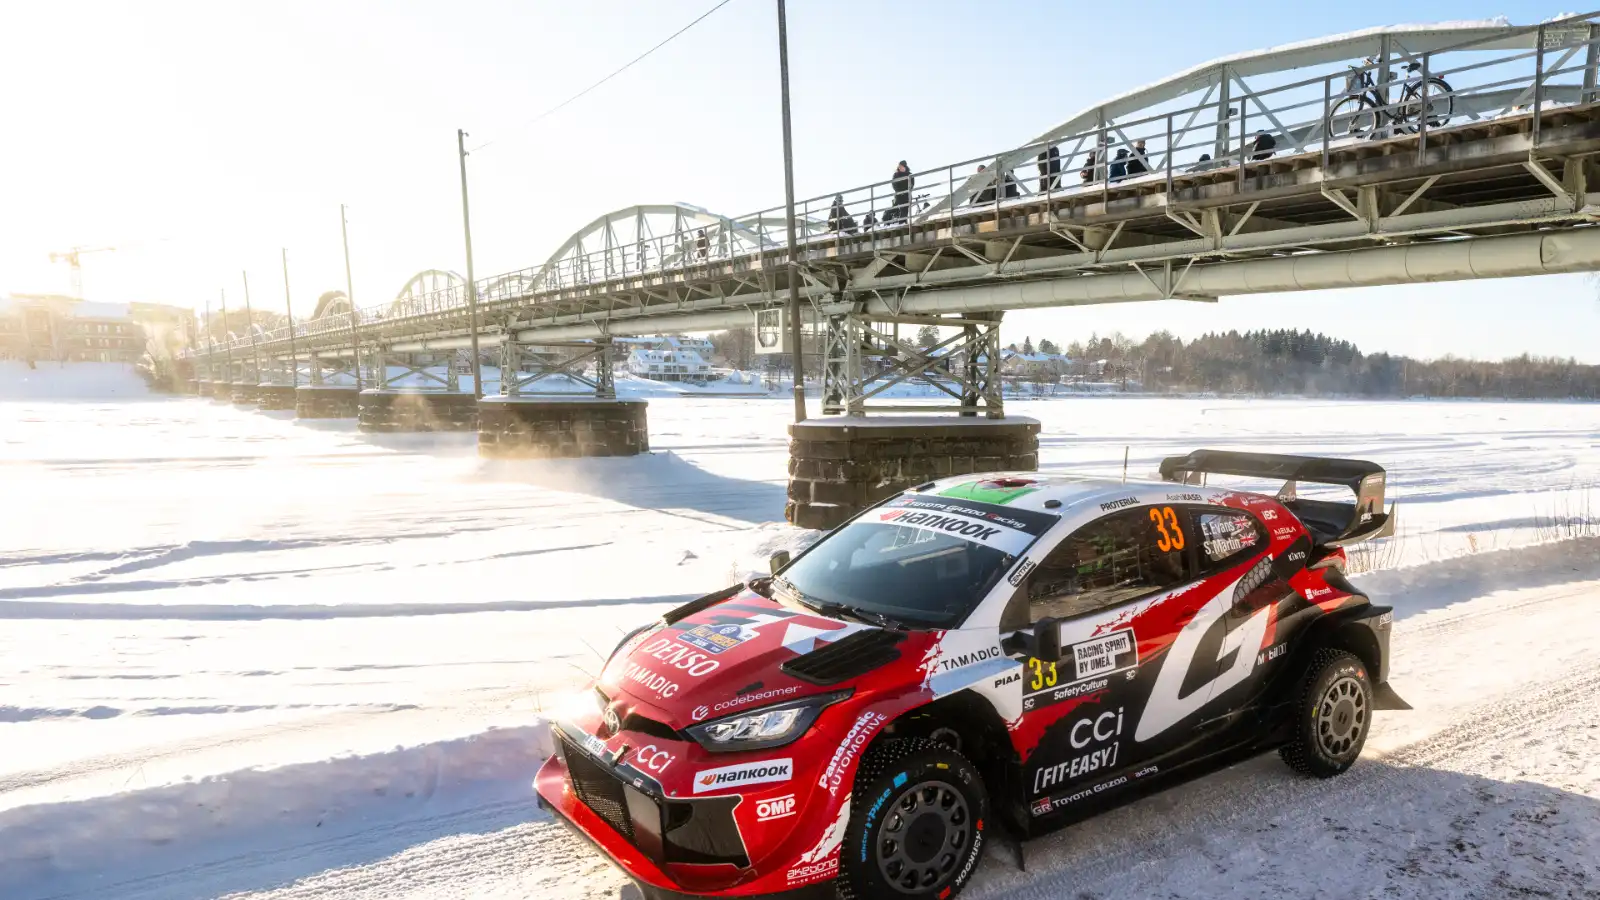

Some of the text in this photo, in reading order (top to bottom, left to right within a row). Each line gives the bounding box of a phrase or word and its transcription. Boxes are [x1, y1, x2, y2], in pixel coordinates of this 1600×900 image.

[909, 501, 945, 510] TOYOTA
[986, 513, 1026, 529] Racing
[1100, 496, 1140, 511] PROTERIAL
[1149, 506, 1185, 552] 33
[1009, 559, 1034, 587] CENTRAL
[641, 638, 720, 677] DENSO
[940, 646, 999, 671] TAMADIC
[1077, 637, 1127, 660] RACING SPIRIT
[624, 662, 679, 698] TAMADIC
[994, 673, 1021, 688] PIAA
[1028, 656, 1058, 690] 33
[1079, 660, 1089, 674] BY
[714, 686, 799, 711] codebeamer
[1054, 679, 1108, 700] SafetyCulture
[818, 711, 875, 790] Panasonic
[829, 713, 888, 797] AUTOMOTIVE
[1052, 789, 1093, 808] TOYOTA
[1093, 776, 1128, 793] GAZOO
[757, 797, 796, 817] OMP
